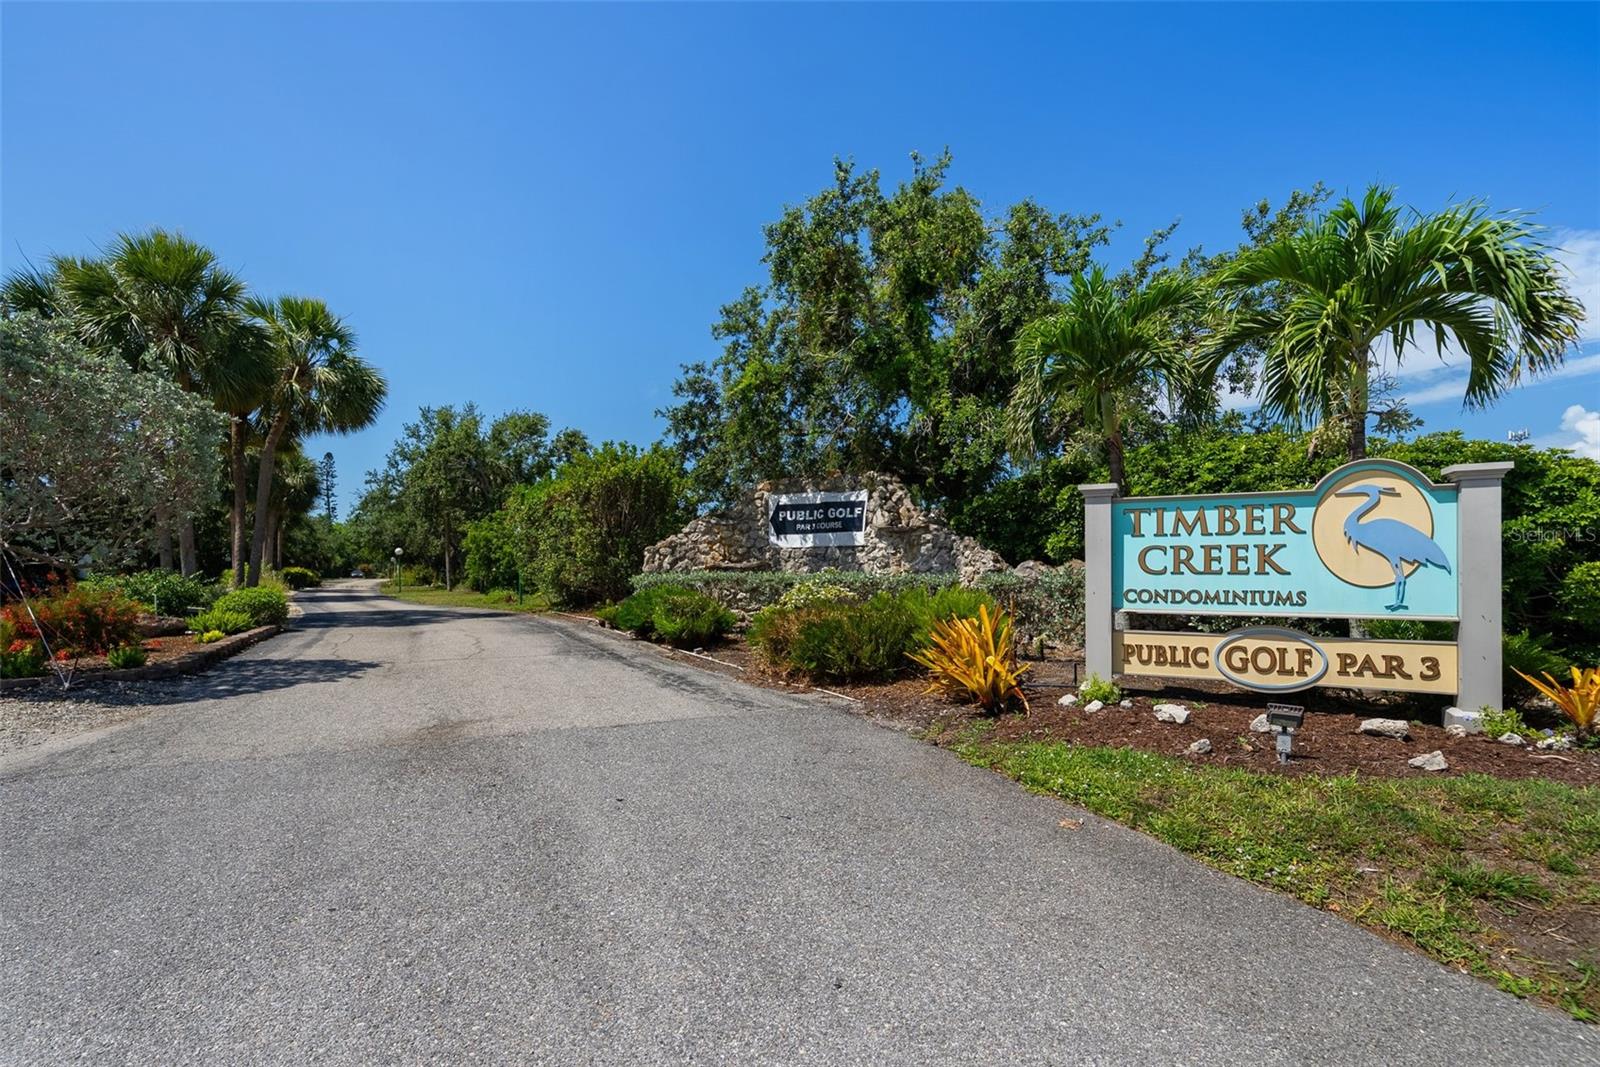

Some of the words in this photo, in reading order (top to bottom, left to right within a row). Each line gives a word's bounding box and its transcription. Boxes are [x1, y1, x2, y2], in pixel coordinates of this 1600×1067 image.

[778, 509, 824, 521] PUBLIC
[827, 507, 863, 519] GOLF
[796, 523, 811, 531] PAR
[816, 521, 842, 530] COURSE
[1123, 503, 1307, 538] TIMBER
[1138, 543, 1291, 576] CREEK
[1123, 588, 1307, 607] CONDOMINIUMS
[1122, 643, 1209, 669] PUBLIC
[1224, 645, 1315, 677] GOLF
[1336, 653, 1413, 681] PAR
[1420, 656, 1441, 681] 3
